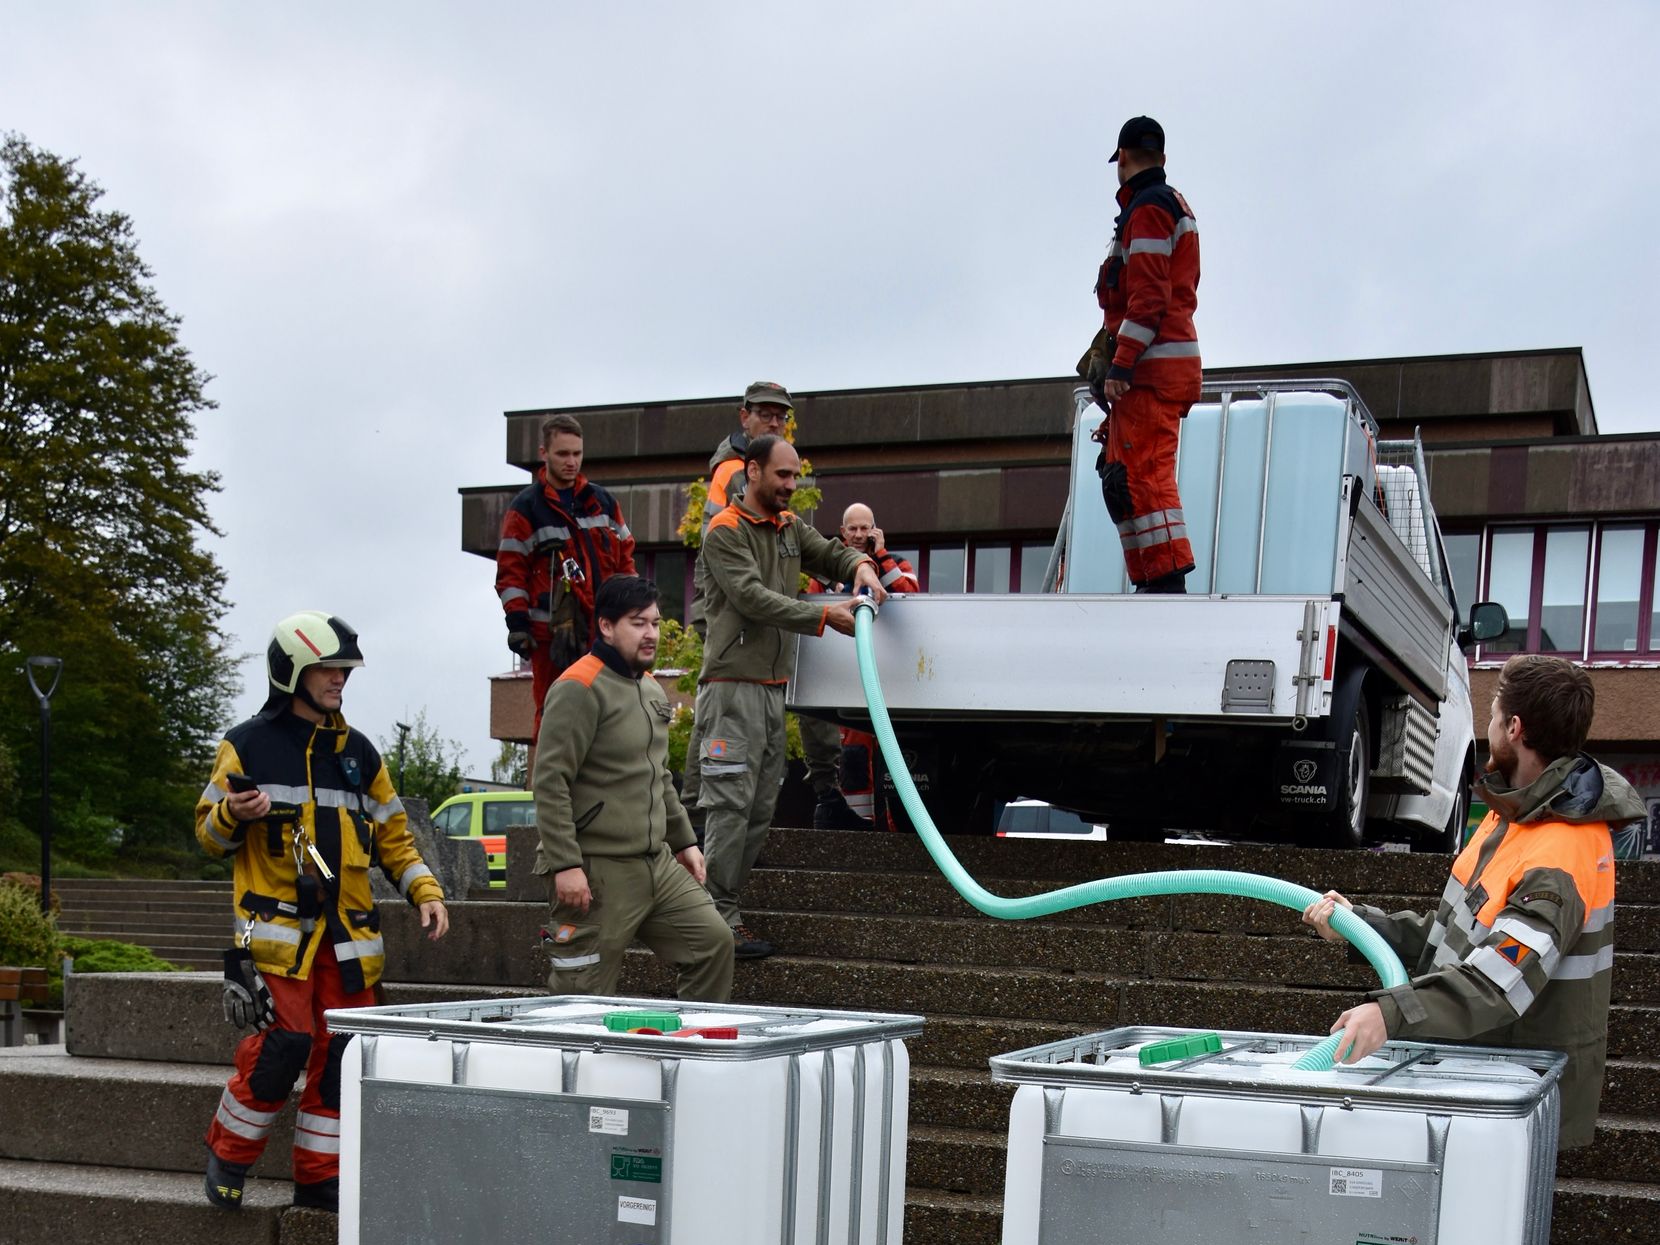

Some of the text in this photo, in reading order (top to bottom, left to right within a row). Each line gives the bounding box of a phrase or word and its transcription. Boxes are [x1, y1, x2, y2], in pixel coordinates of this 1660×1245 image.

[883, 772, 929, 782] SNIA
[1280, 785, 1327, 795] SCANIA
[1331, 1169, 1364, 1178] IBC_8405
[620, 1200, 656, 1212] VORGEREINIGT
